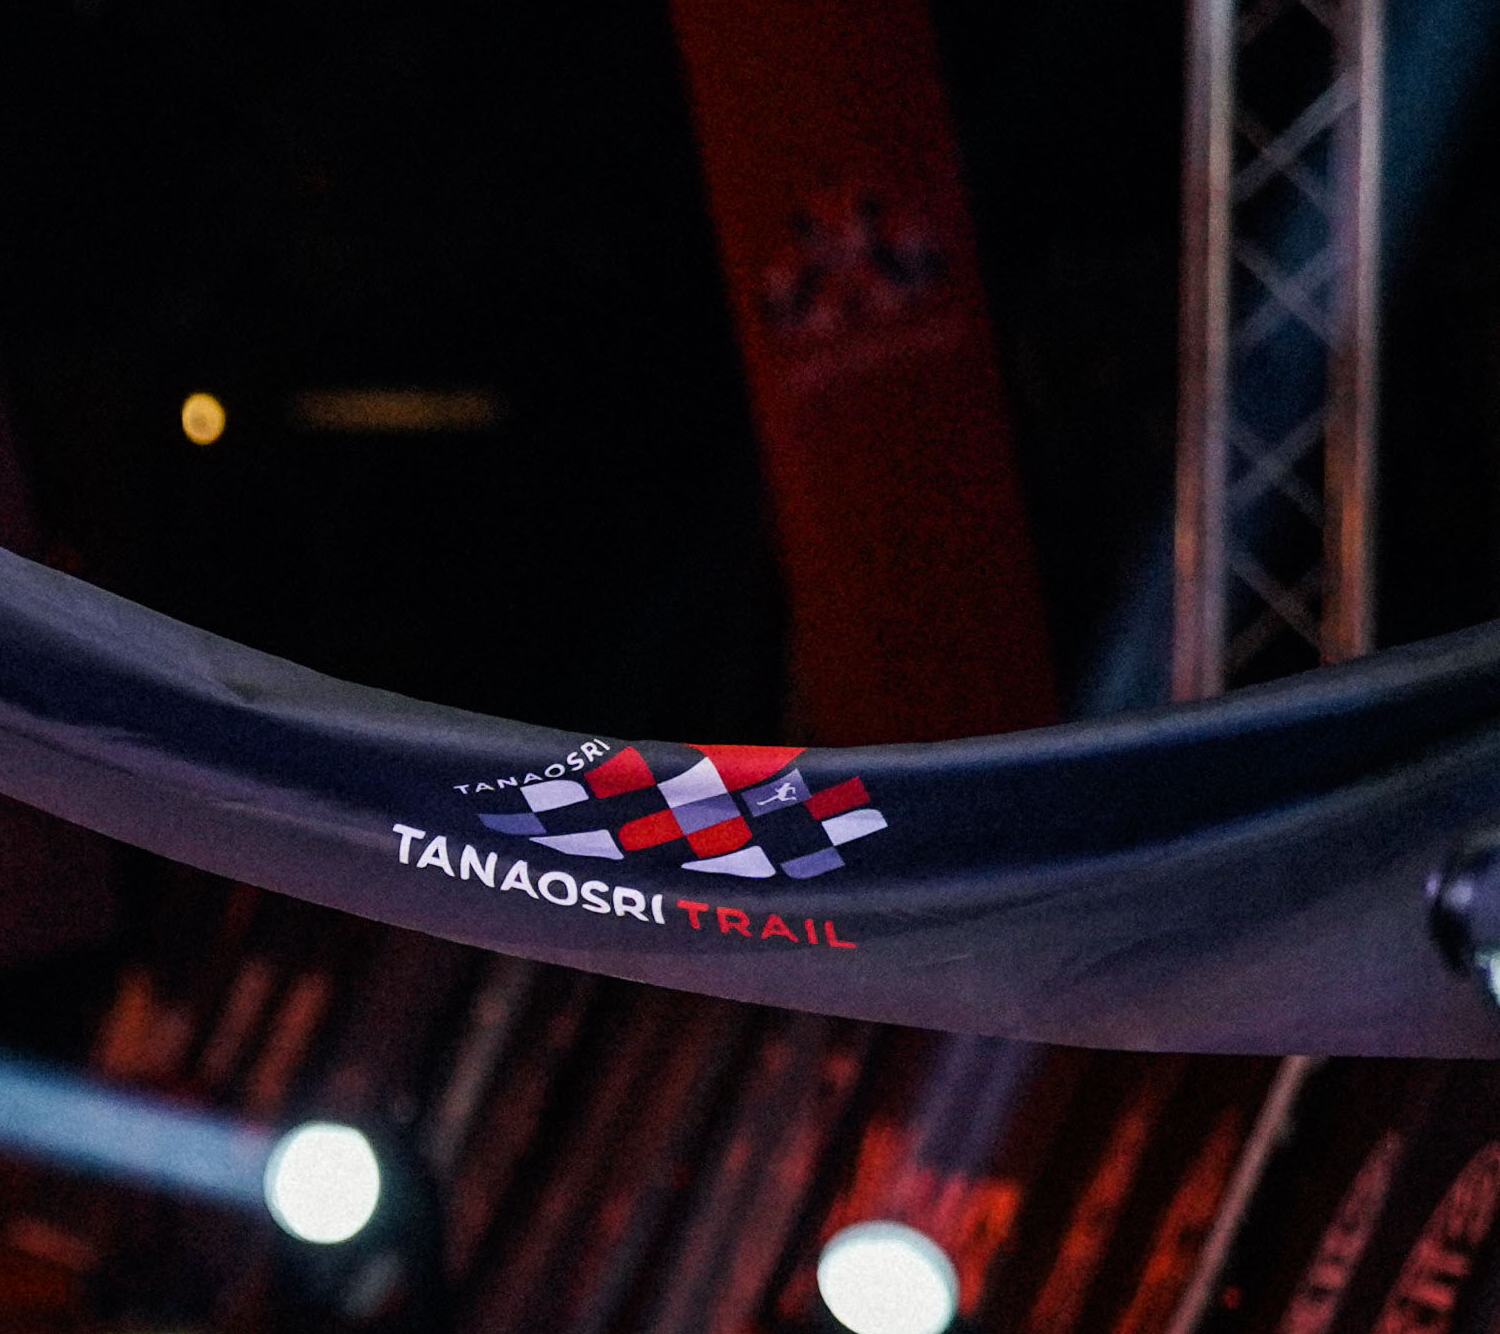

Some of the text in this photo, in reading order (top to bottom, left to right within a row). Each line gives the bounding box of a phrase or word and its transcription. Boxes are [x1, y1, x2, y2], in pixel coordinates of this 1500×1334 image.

[453, 737, 610, 796] TANAOSRI
[392, 823, 857, 950] TANAOSRI TRAIL
